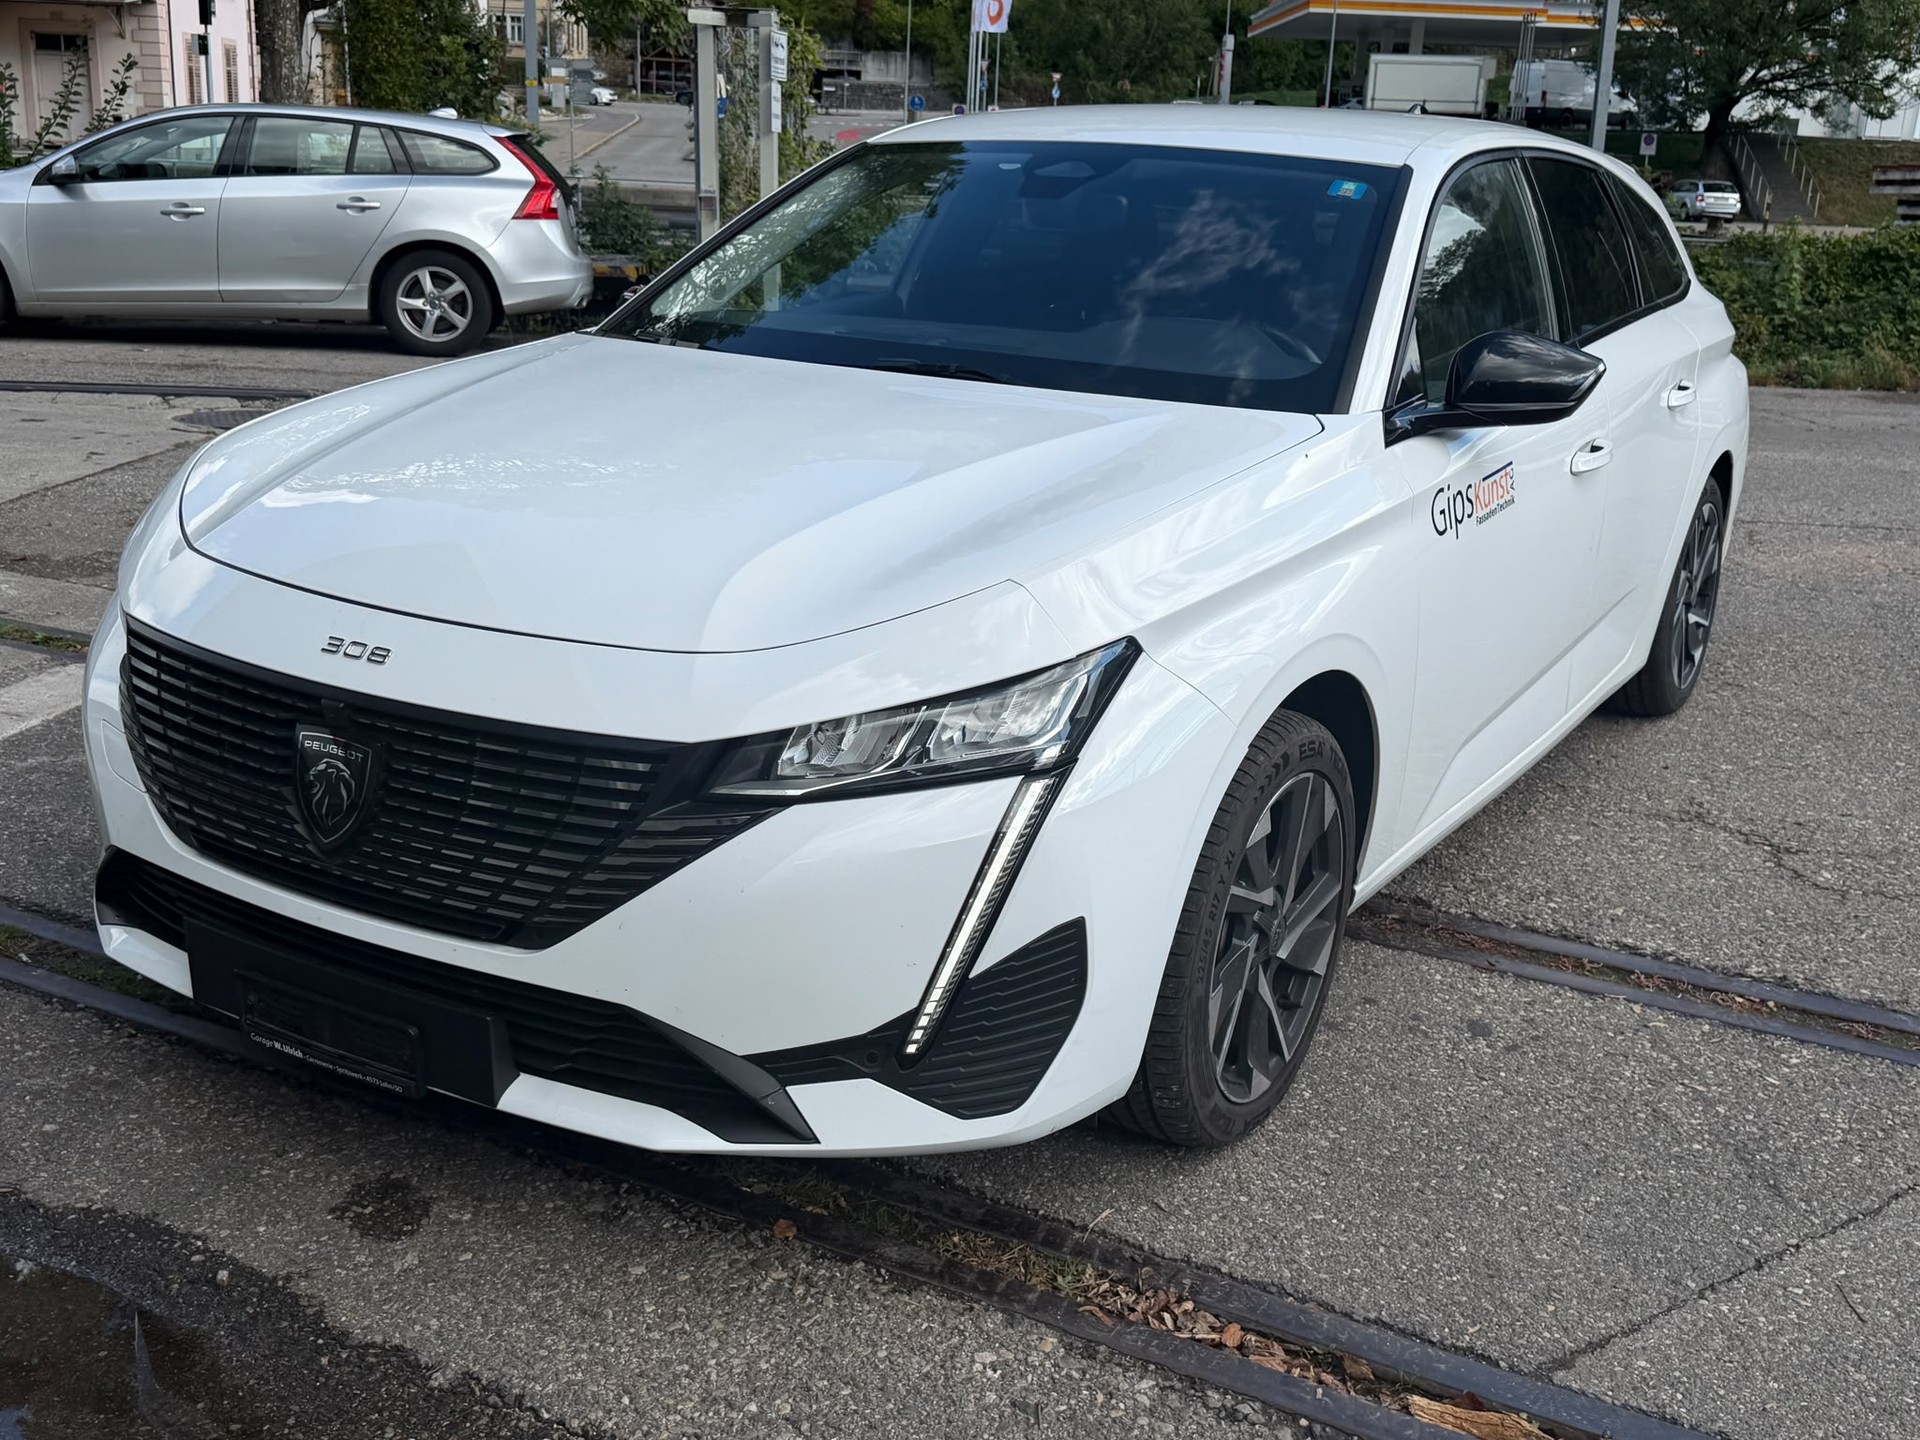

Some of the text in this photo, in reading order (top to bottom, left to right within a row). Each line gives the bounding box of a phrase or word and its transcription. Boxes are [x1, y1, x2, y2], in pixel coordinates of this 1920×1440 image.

[320, 635, 392, 665] 308
[303, 739, 365, 763] PEUGEOT
[1208, 892, 1222, 922] R17
[1224, 848, 1237, 871] XL
[249, 1031, 274, 1049] Garage
